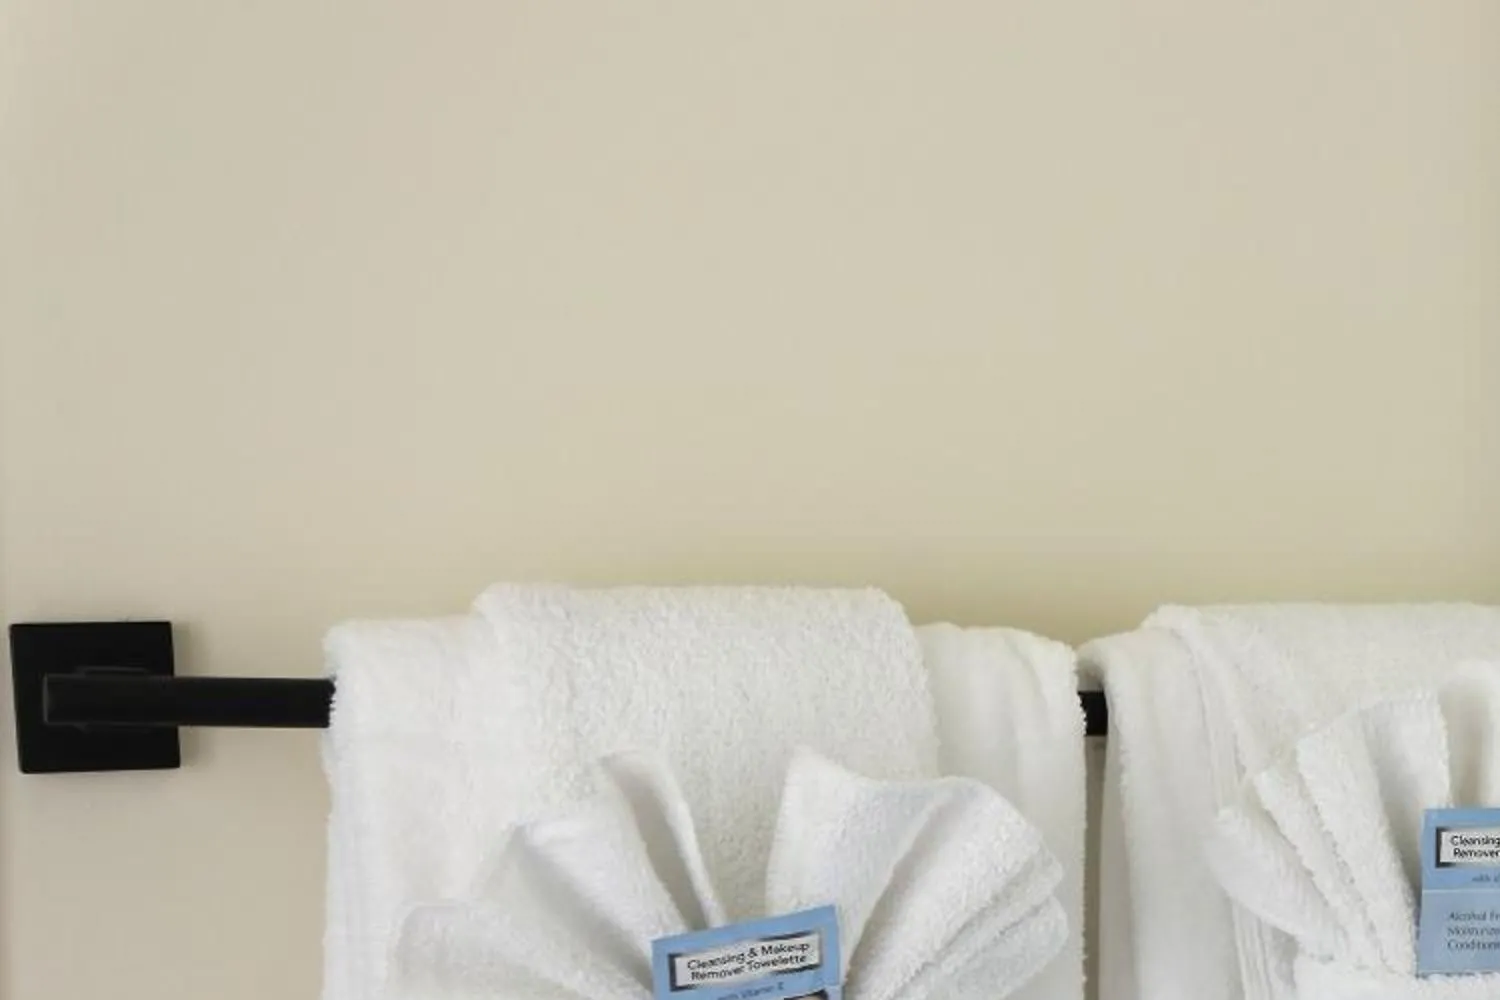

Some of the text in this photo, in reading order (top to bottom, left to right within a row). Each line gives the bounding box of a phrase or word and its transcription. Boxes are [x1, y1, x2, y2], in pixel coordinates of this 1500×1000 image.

[1450, 835, 1500, 847] Cleansing
[1453, 848, 1500, 858] Remover
[1448, 911, 1486, 920] Alcohol
[687, 942, 810, 970] Cleansing & Makeup
[691, 954, 808, 980] Remover Towelette
